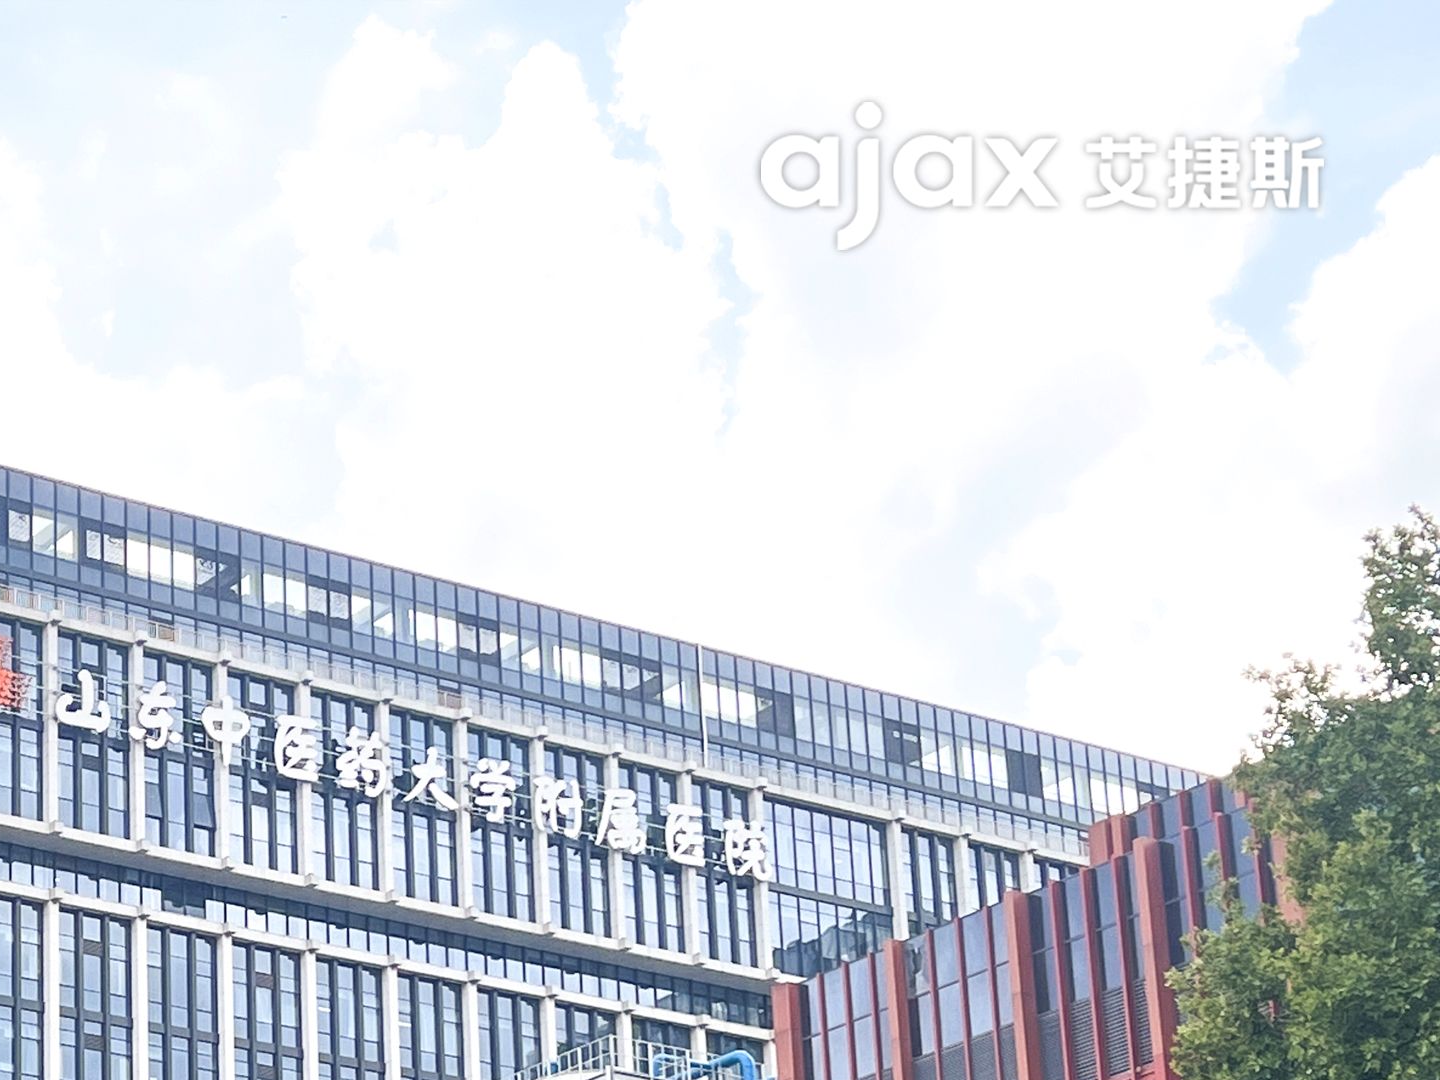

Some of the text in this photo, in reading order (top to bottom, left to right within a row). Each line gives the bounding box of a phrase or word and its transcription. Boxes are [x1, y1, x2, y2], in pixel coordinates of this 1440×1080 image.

[55, 669, 775, 883] 山东中医药大学附属医院
